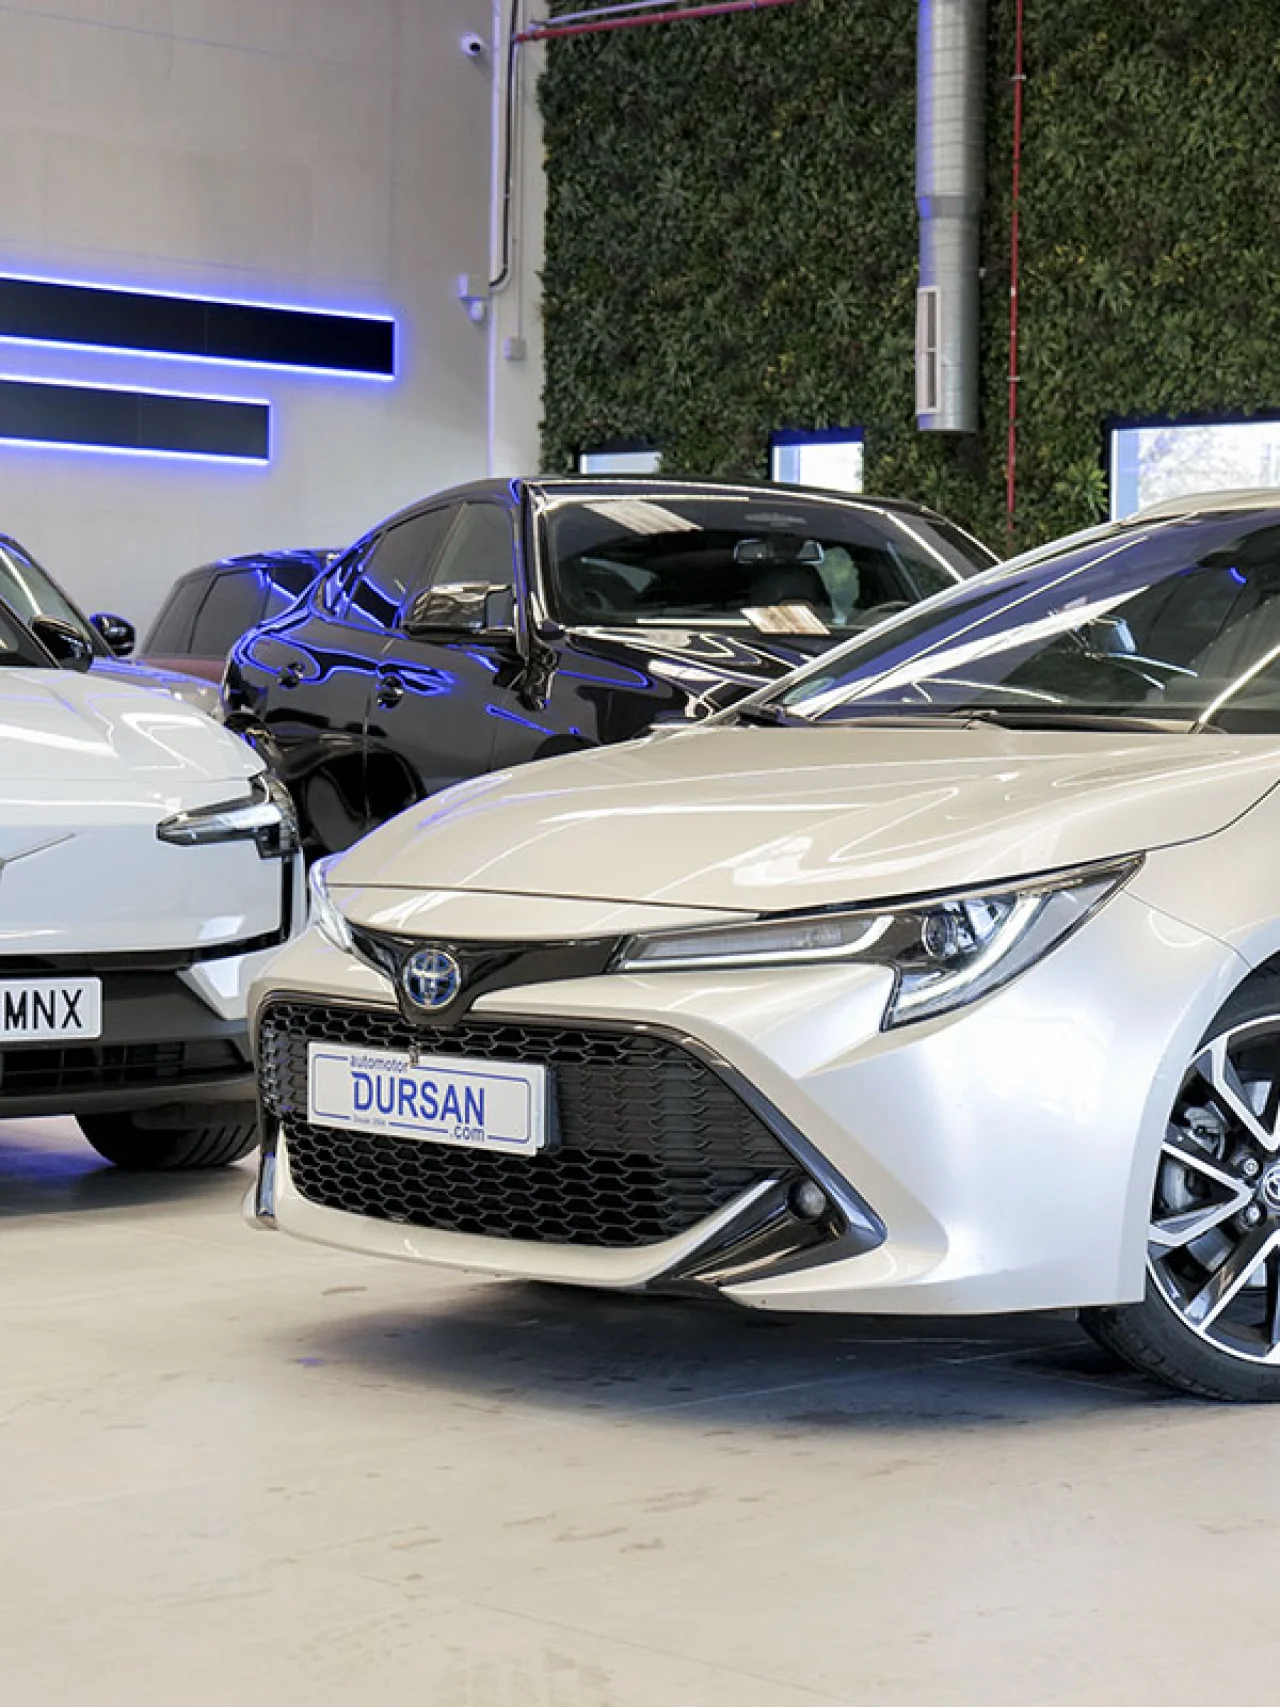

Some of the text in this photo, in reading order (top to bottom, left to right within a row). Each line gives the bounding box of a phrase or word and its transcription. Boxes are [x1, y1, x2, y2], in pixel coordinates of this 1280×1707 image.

[4, 988, 83, 1031] MNX
[351, 1071, 485, 1127] DURSAN
[450, 1126, 485, 1142] .com
